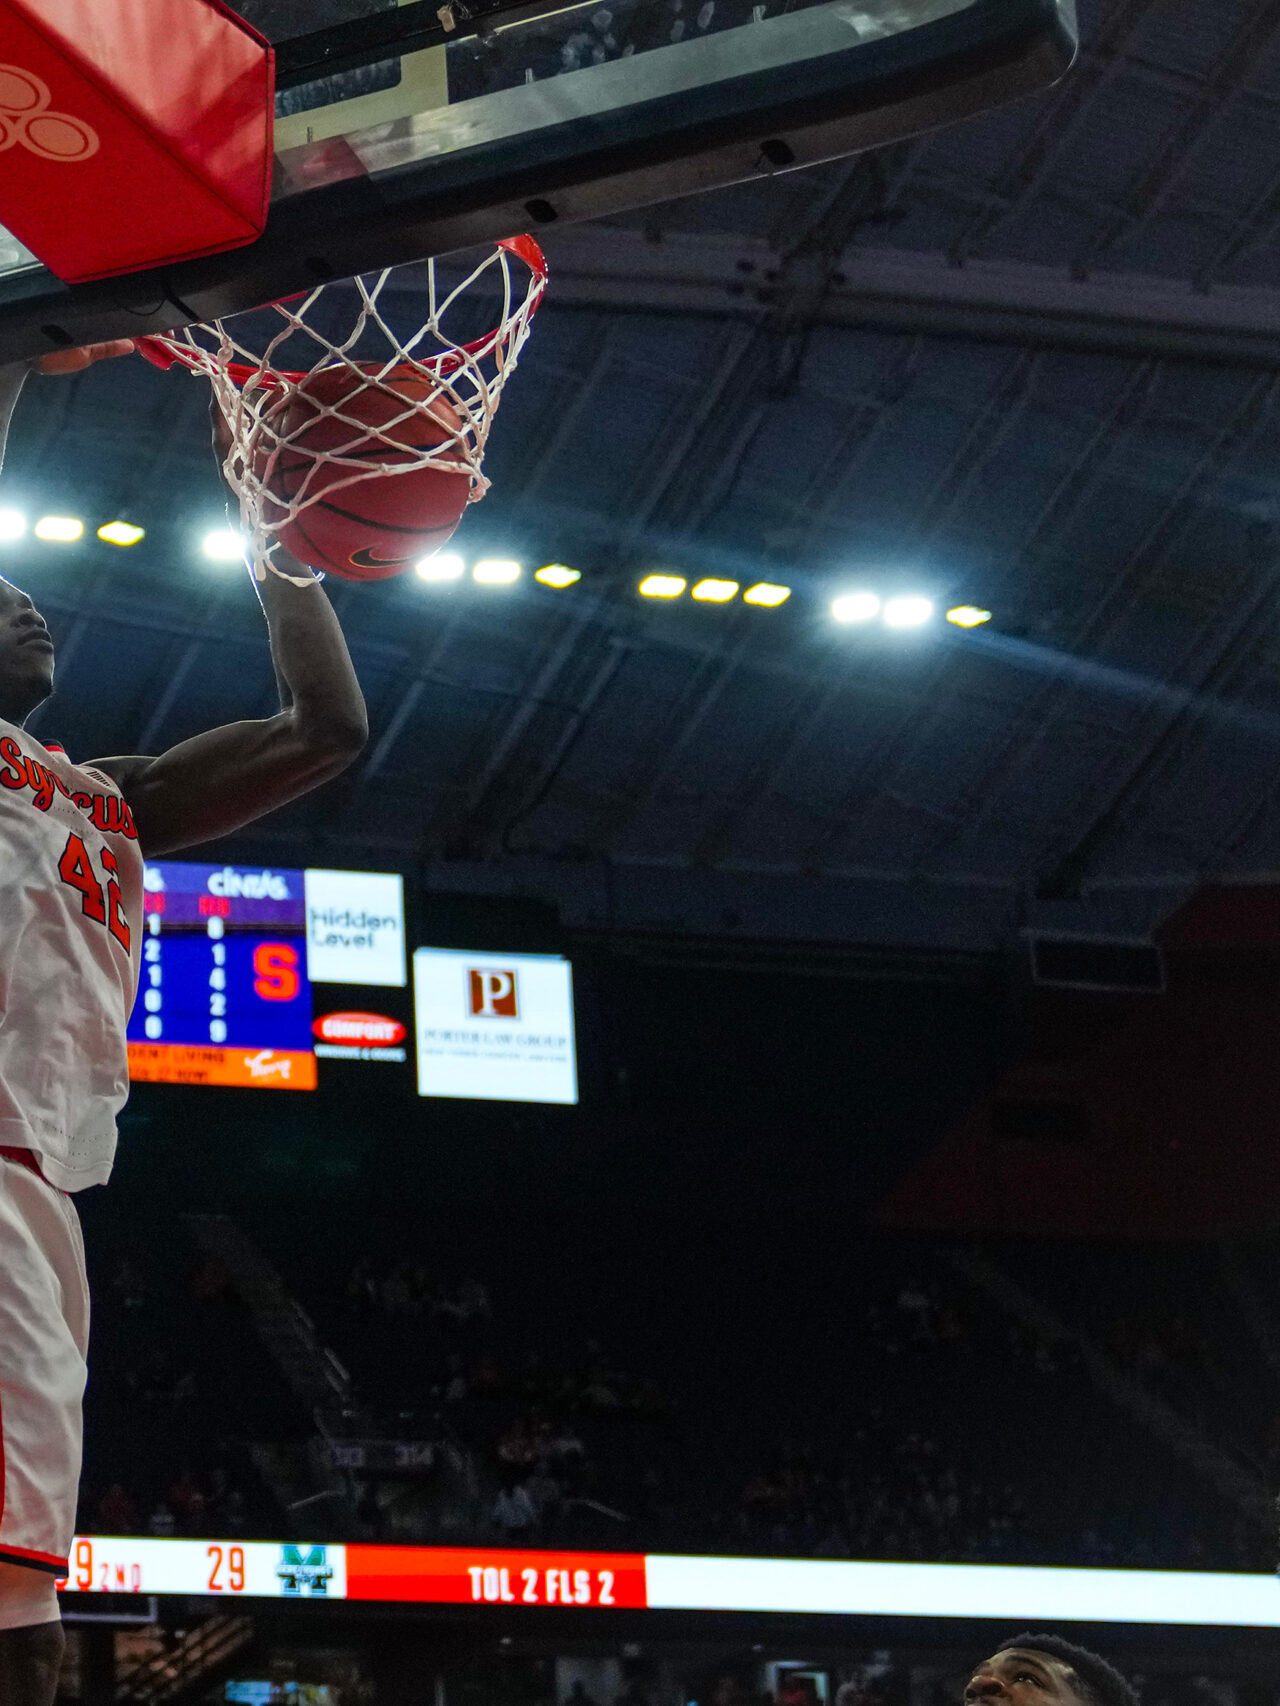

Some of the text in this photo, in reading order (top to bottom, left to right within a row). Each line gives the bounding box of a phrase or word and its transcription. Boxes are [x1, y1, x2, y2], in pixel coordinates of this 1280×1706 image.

[58, 832, 130, 957] 42
[310, 908, 396, 930] Hidden
[311, 931, 373, 949] Level
[254, 943, 299, 1002] S
[476, 971, 512, 1016] P
[207, 1546, 245, 1591] 29
[468, 1567, 615, 1605] TOL 2 FLS 2
